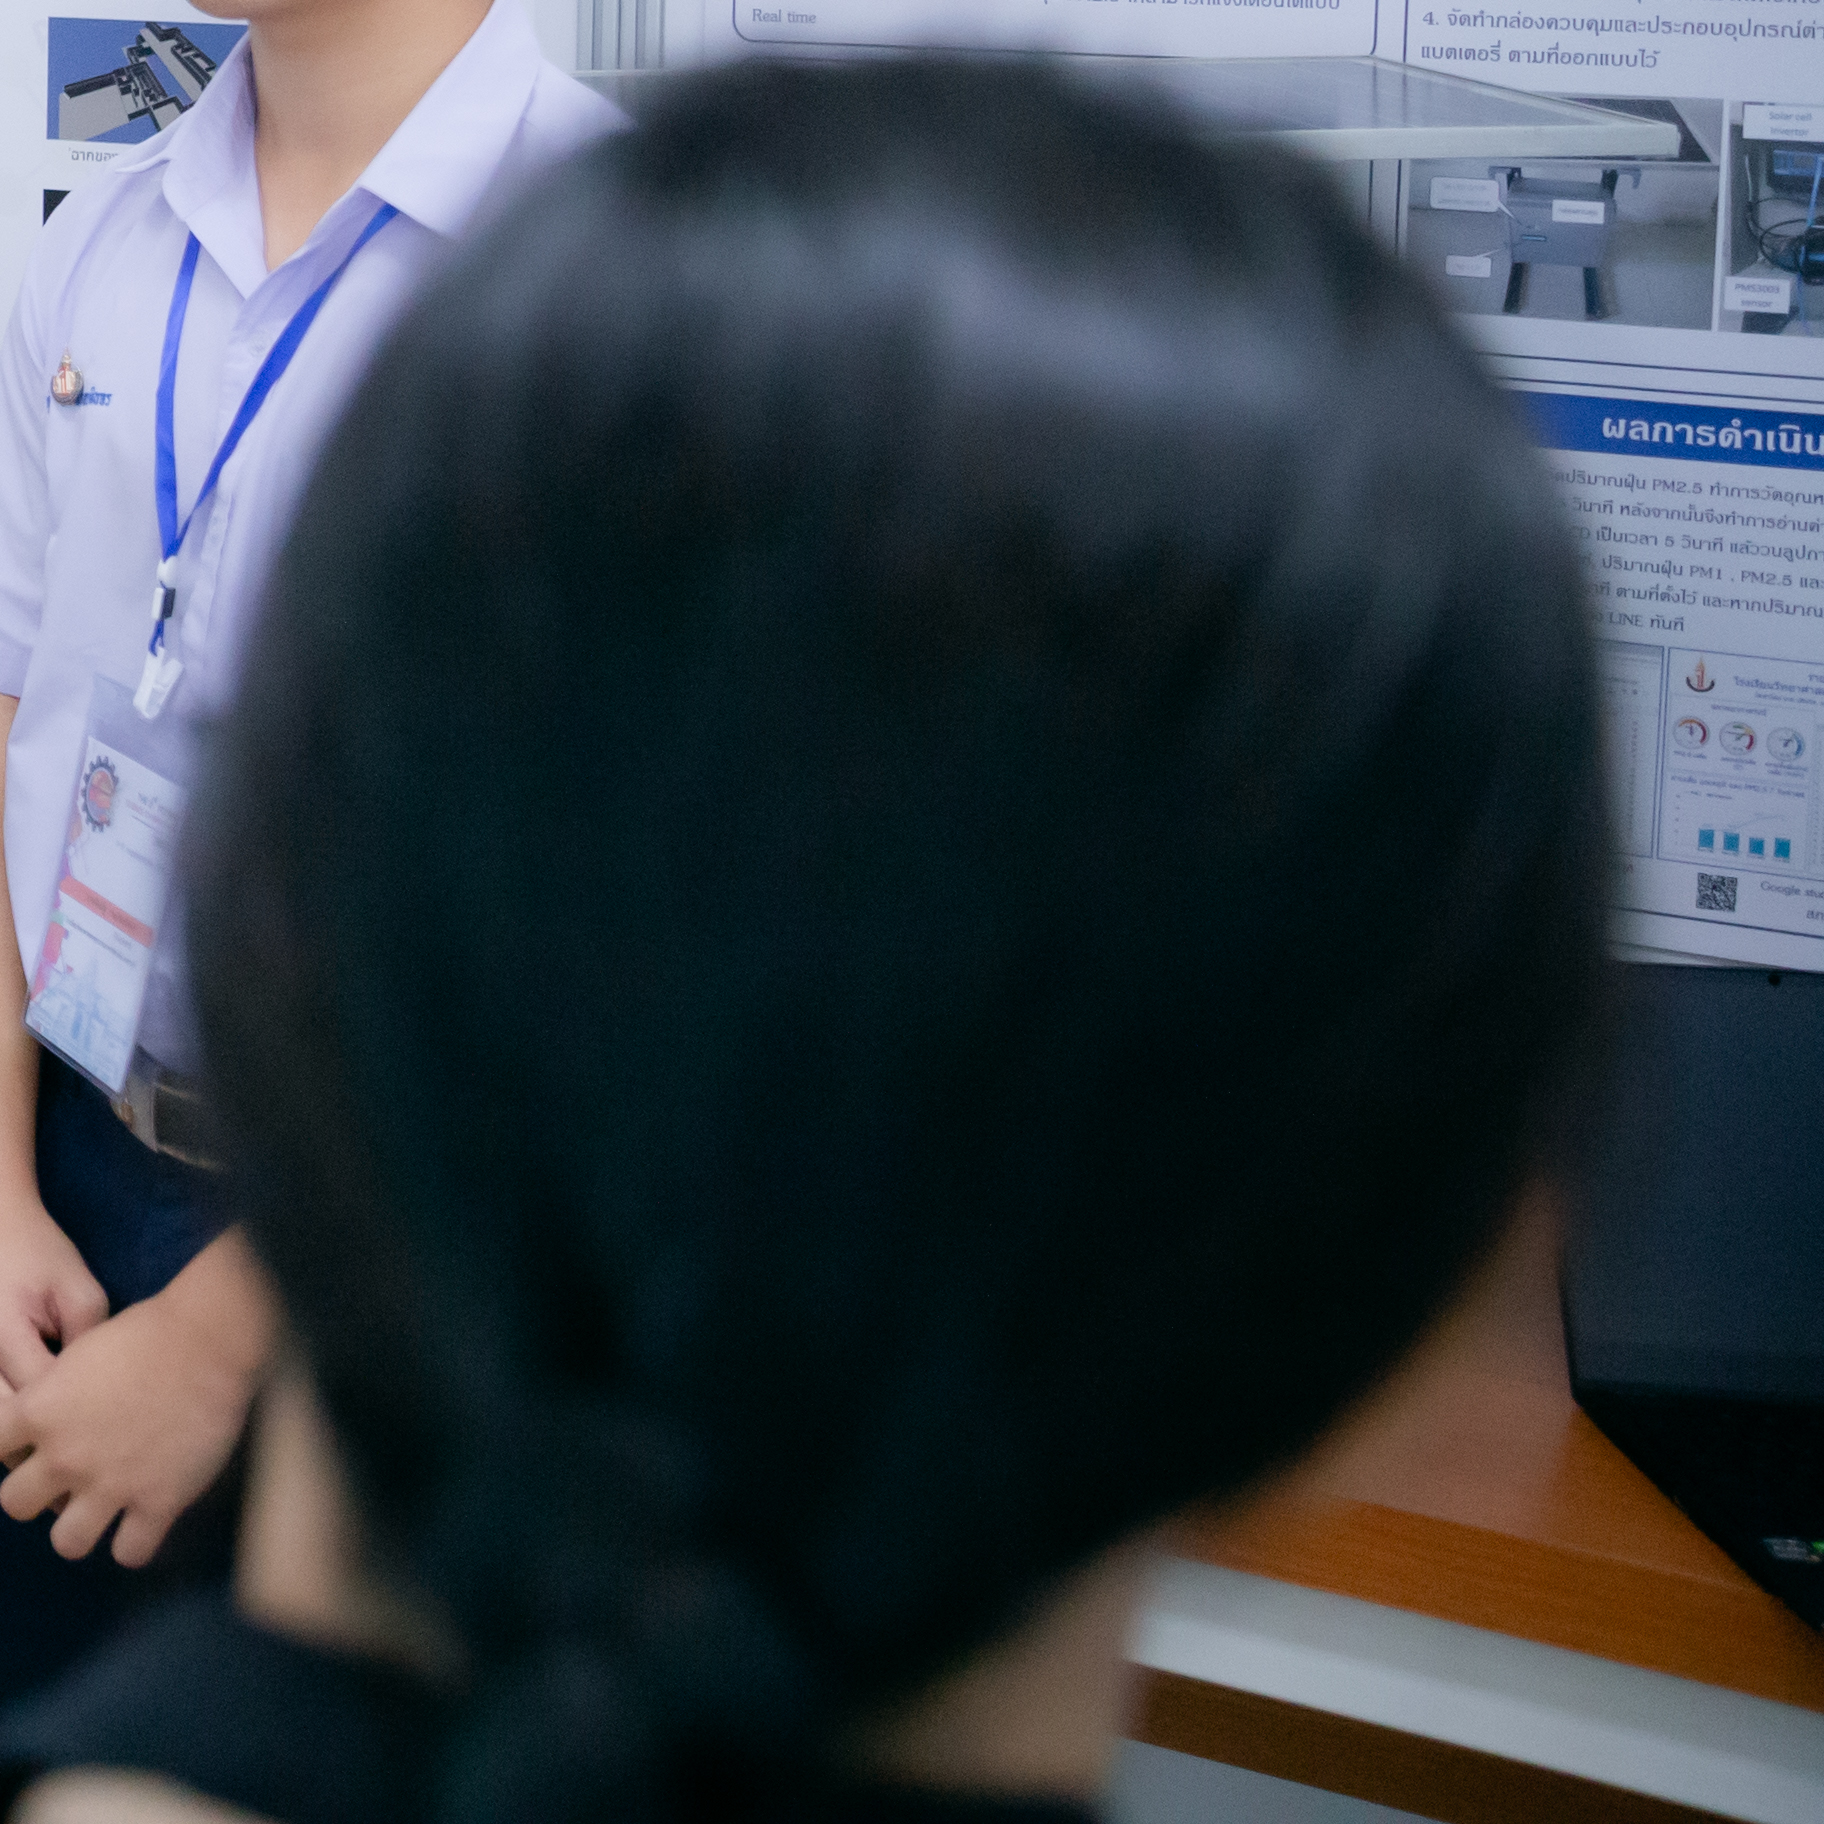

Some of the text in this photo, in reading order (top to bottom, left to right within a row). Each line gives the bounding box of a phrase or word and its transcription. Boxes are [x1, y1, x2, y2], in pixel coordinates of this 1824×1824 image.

[752, 8, 817, 24] Real time
[1602, 418, 1824, 456] ผลการดำเนิน
[1652, 479, 1703, 495] PM2.5
[1740, 568, 1793, 587] PM2.5
